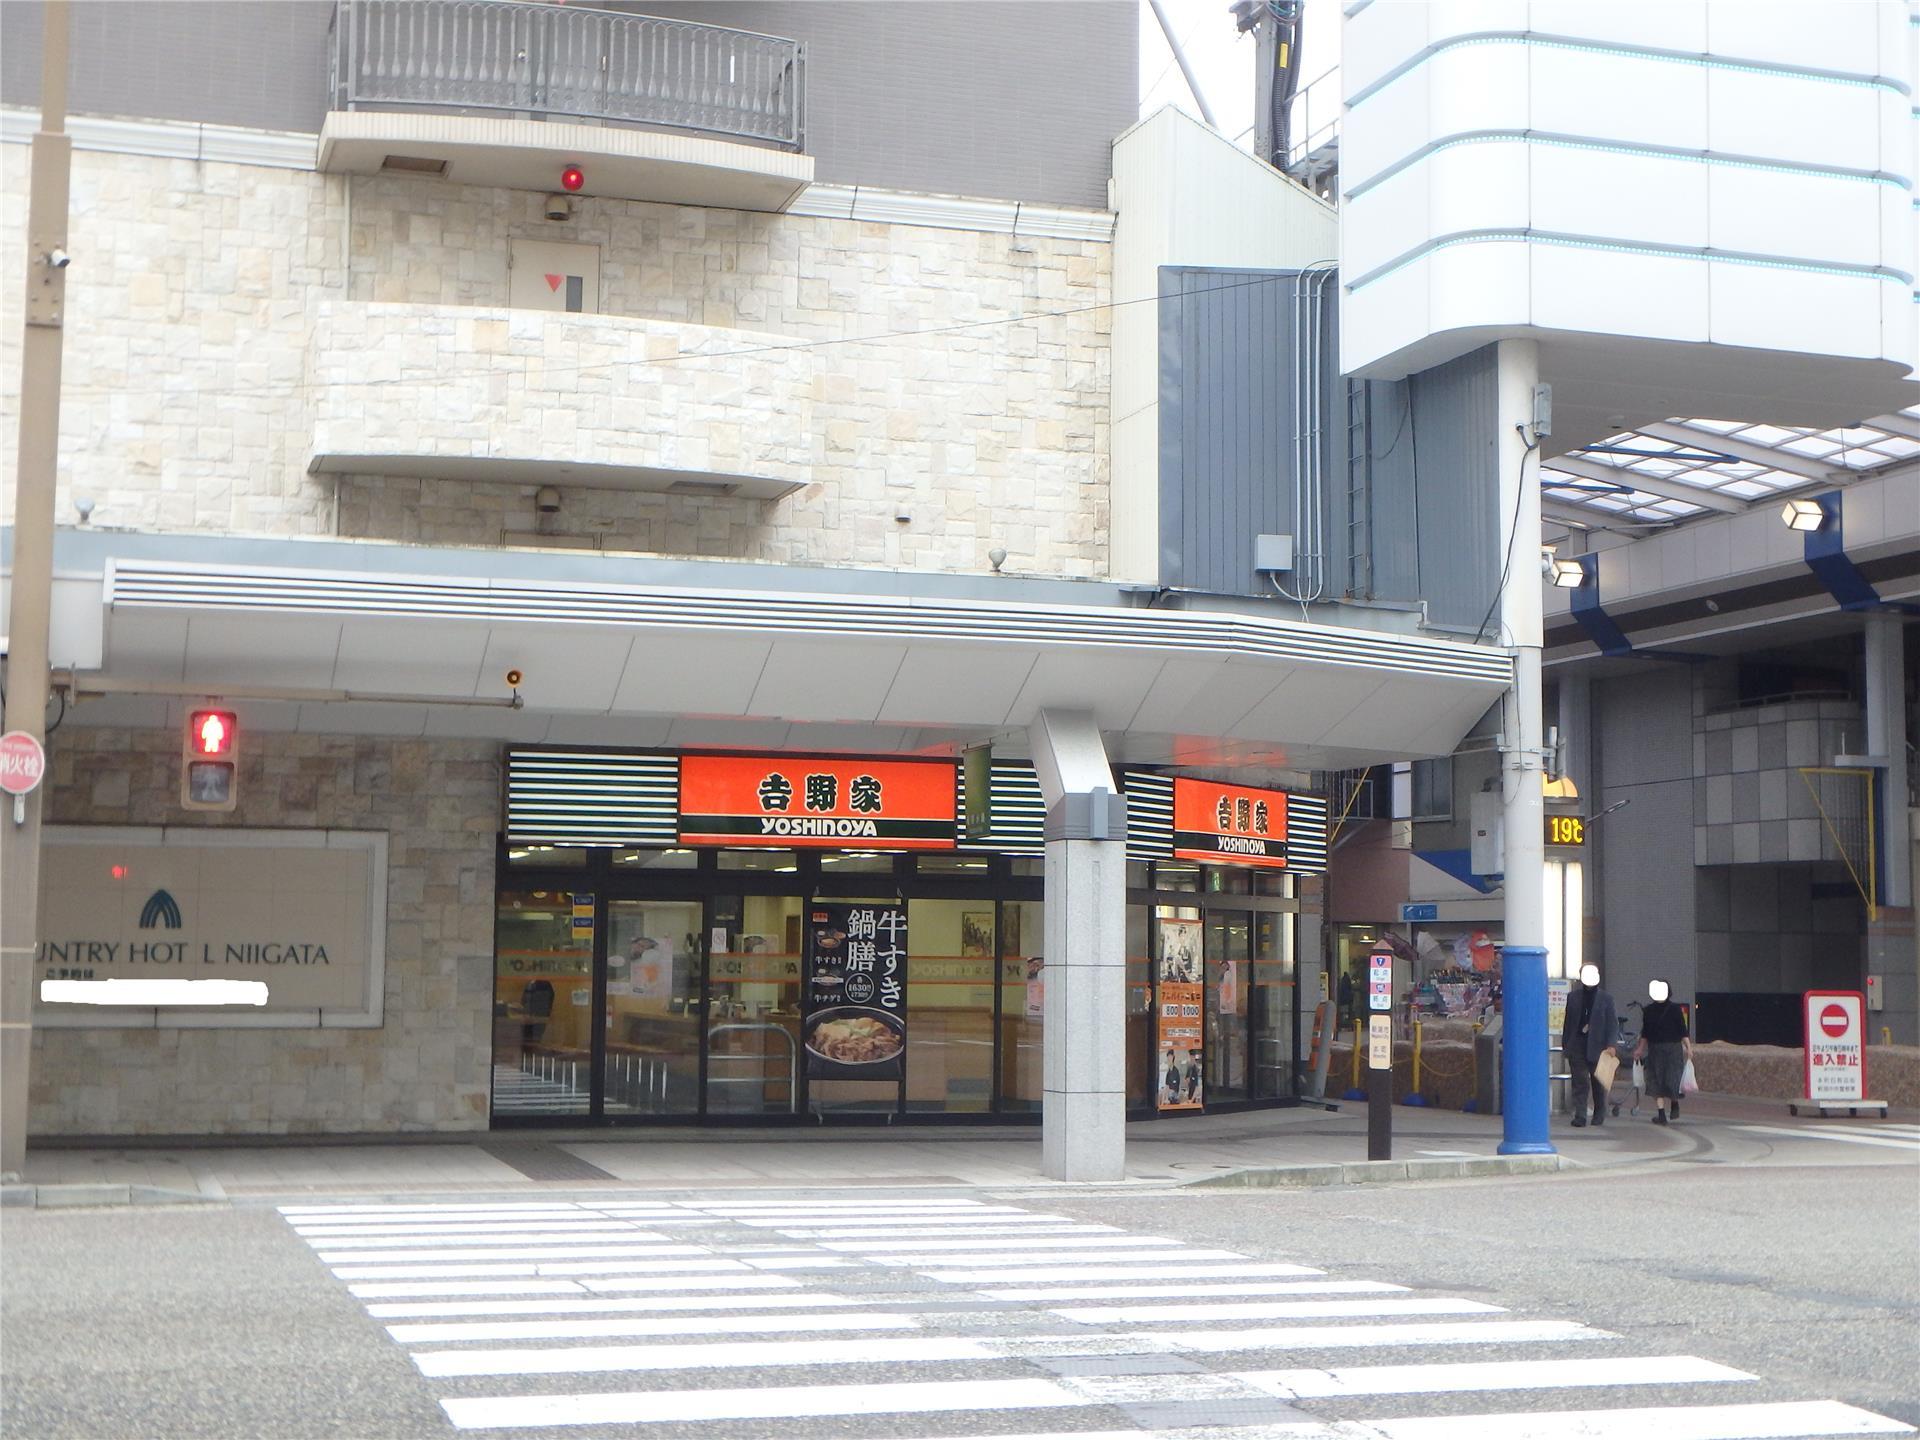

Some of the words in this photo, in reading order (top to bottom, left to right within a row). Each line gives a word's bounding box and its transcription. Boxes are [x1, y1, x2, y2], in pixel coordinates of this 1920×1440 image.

[761, 817, 878, 837] YOSHINOYA
[1217, 835, 1266, 855] YOSHINOYA
[845, 909, 876, 972] 鍋膳
[225, 943, 330, 965] NIIGATA
[877, 910, 908, 1008] 牛すき
[1813, 1053, 1858, 1066] 進入禁止
